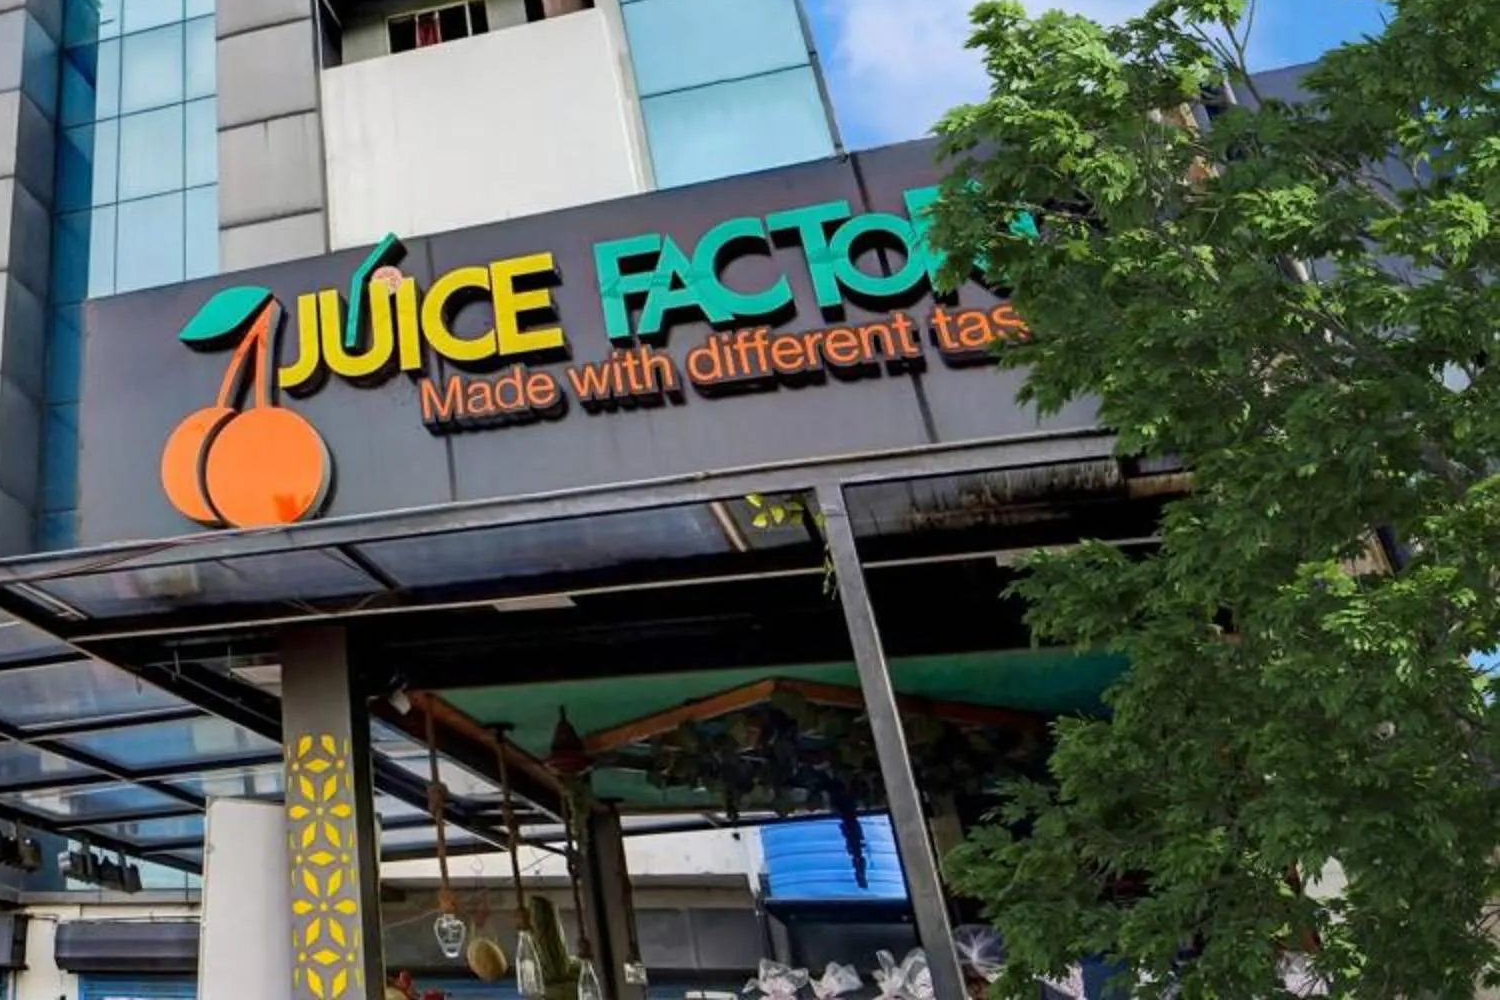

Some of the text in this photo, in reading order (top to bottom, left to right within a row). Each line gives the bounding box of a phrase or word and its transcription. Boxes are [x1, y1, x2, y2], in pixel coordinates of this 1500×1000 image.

[277, 182, 1038, 389] JUICE FACTO
[419, 304, 1030, 424] Made with different tas
